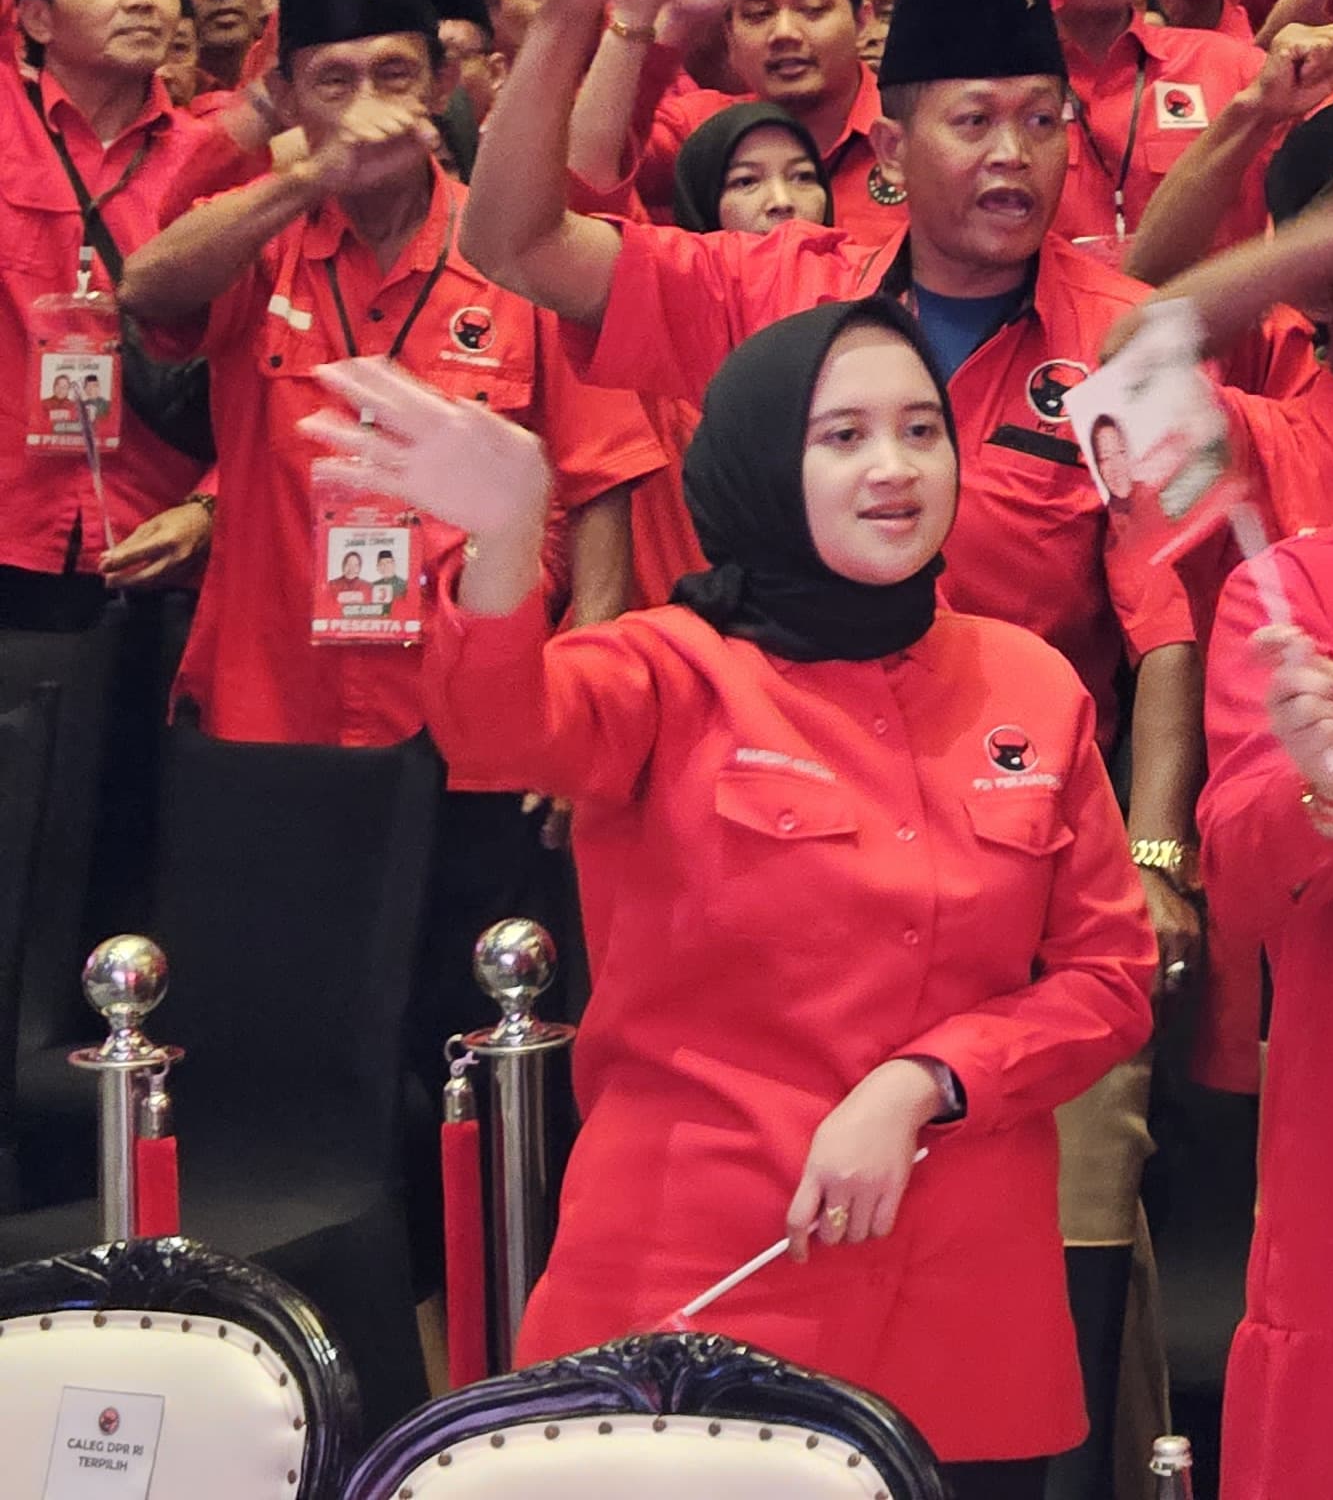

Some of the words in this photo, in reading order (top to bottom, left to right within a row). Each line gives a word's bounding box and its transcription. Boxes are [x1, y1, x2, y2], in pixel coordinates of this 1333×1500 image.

[329, 618, 402, 632] PESERTA
[66, 1438, 104, 1453] CALEG
[106, 1441, 130, 1455] DPR
[78, 1456, 128, 1471] TERPILIH
